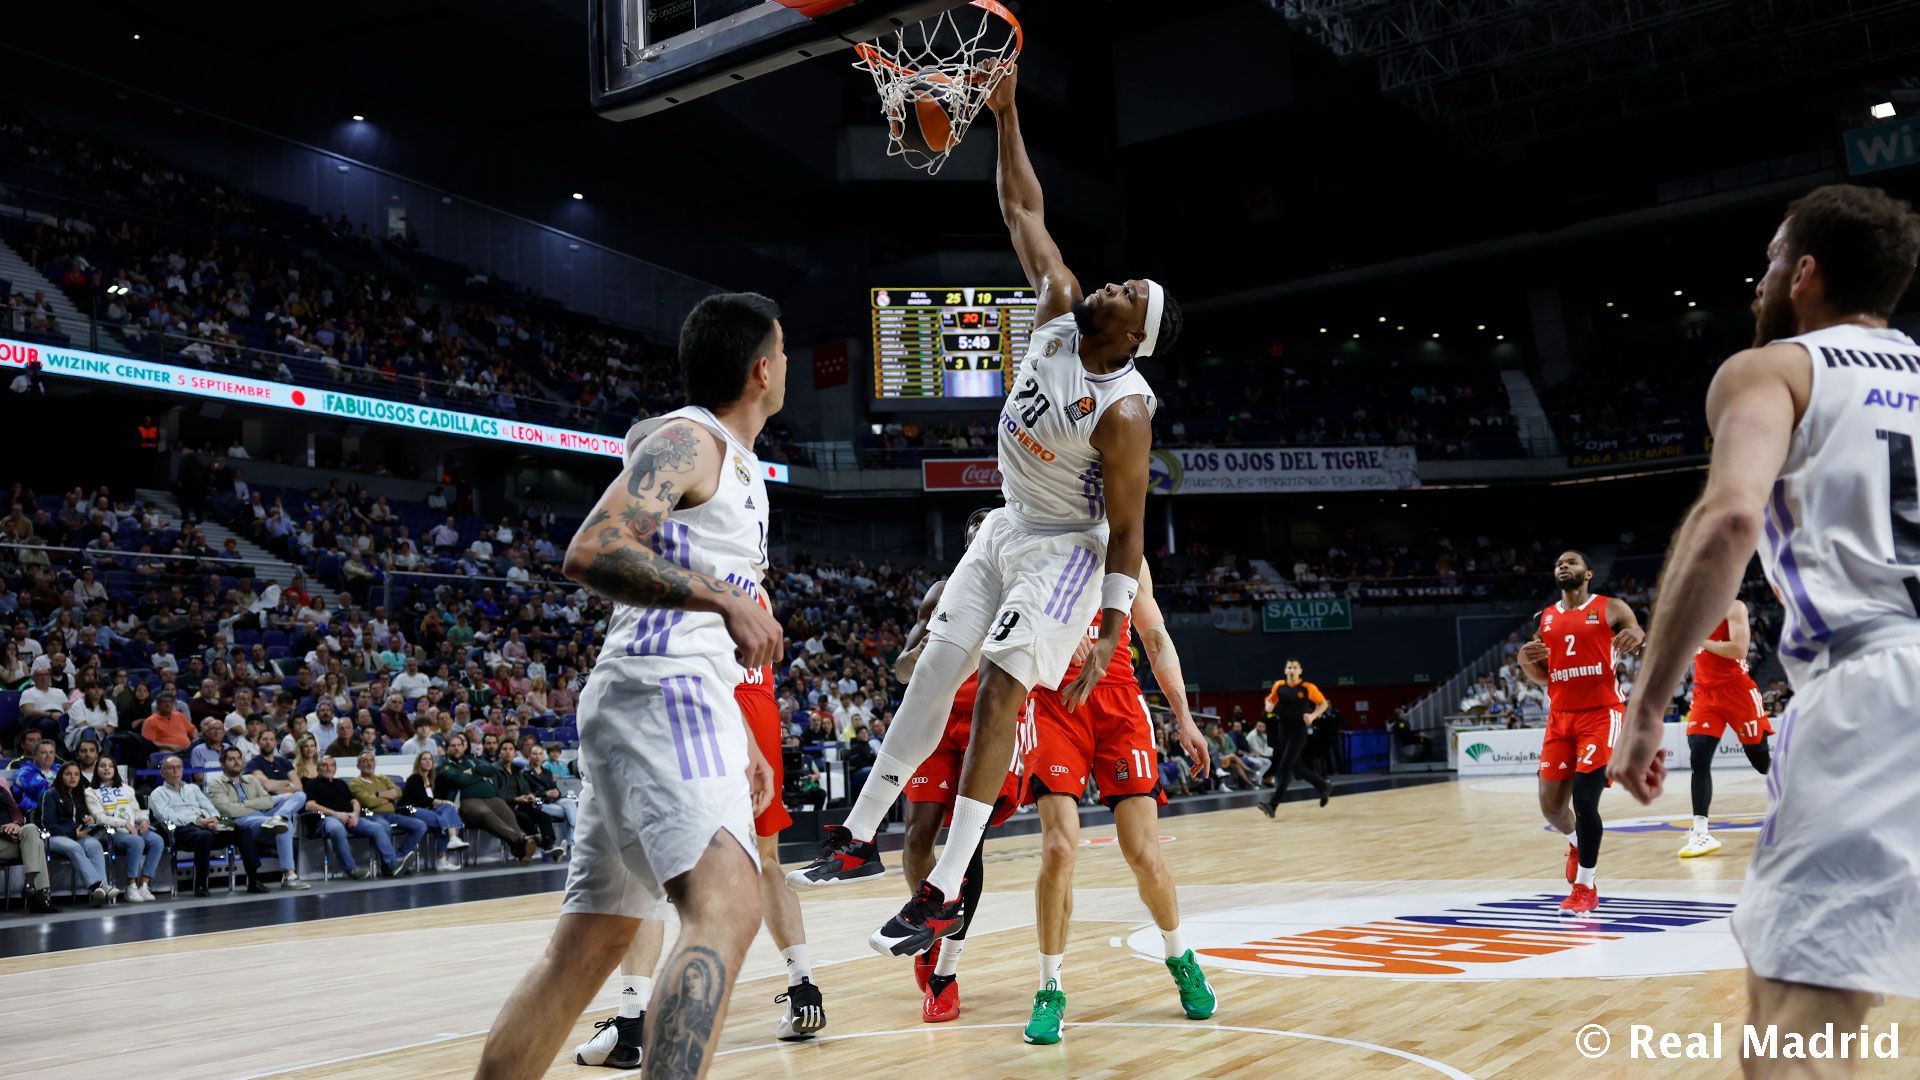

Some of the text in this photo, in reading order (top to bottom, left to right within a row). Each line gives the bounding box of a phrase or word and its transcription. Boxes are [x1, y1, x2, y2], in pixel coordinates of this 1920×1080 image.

[945, 293, 962, 305] 25
[977, 293, 992, 305] 19
[963, 314, 979, 323] 20
[958, 336, 990, 349] 5:49
[955, 358, 964, 369] 3
[982, 358, 989, 368] 1
[46, 353, 110, 375] WIZINK
[115, 365, 171, 384] CENTER
[191, 376, 272, 399] SEPTIEMBRE
[1012, 377, 1051, 429] 28
[326, 394, 415, 424] FABULOSOS
[419, 409, 498, 436] CADILLACS
[511, 425, 542, 443] LEON
[560, 433, 599, 451] RITMO
[1182, 450, 1381, 472] LOS OJOS DEL TIGRE
[1268, 602, 1345, 617] SALIDA
[1290, 617, 1325, 629] EXIT
[1564, 635, 1577, 656] 2
[1550, 662, 1603, 683] siegmund
[1744, 720, 1759, 738] 17
[1131, 749, 1152, 778] 11
